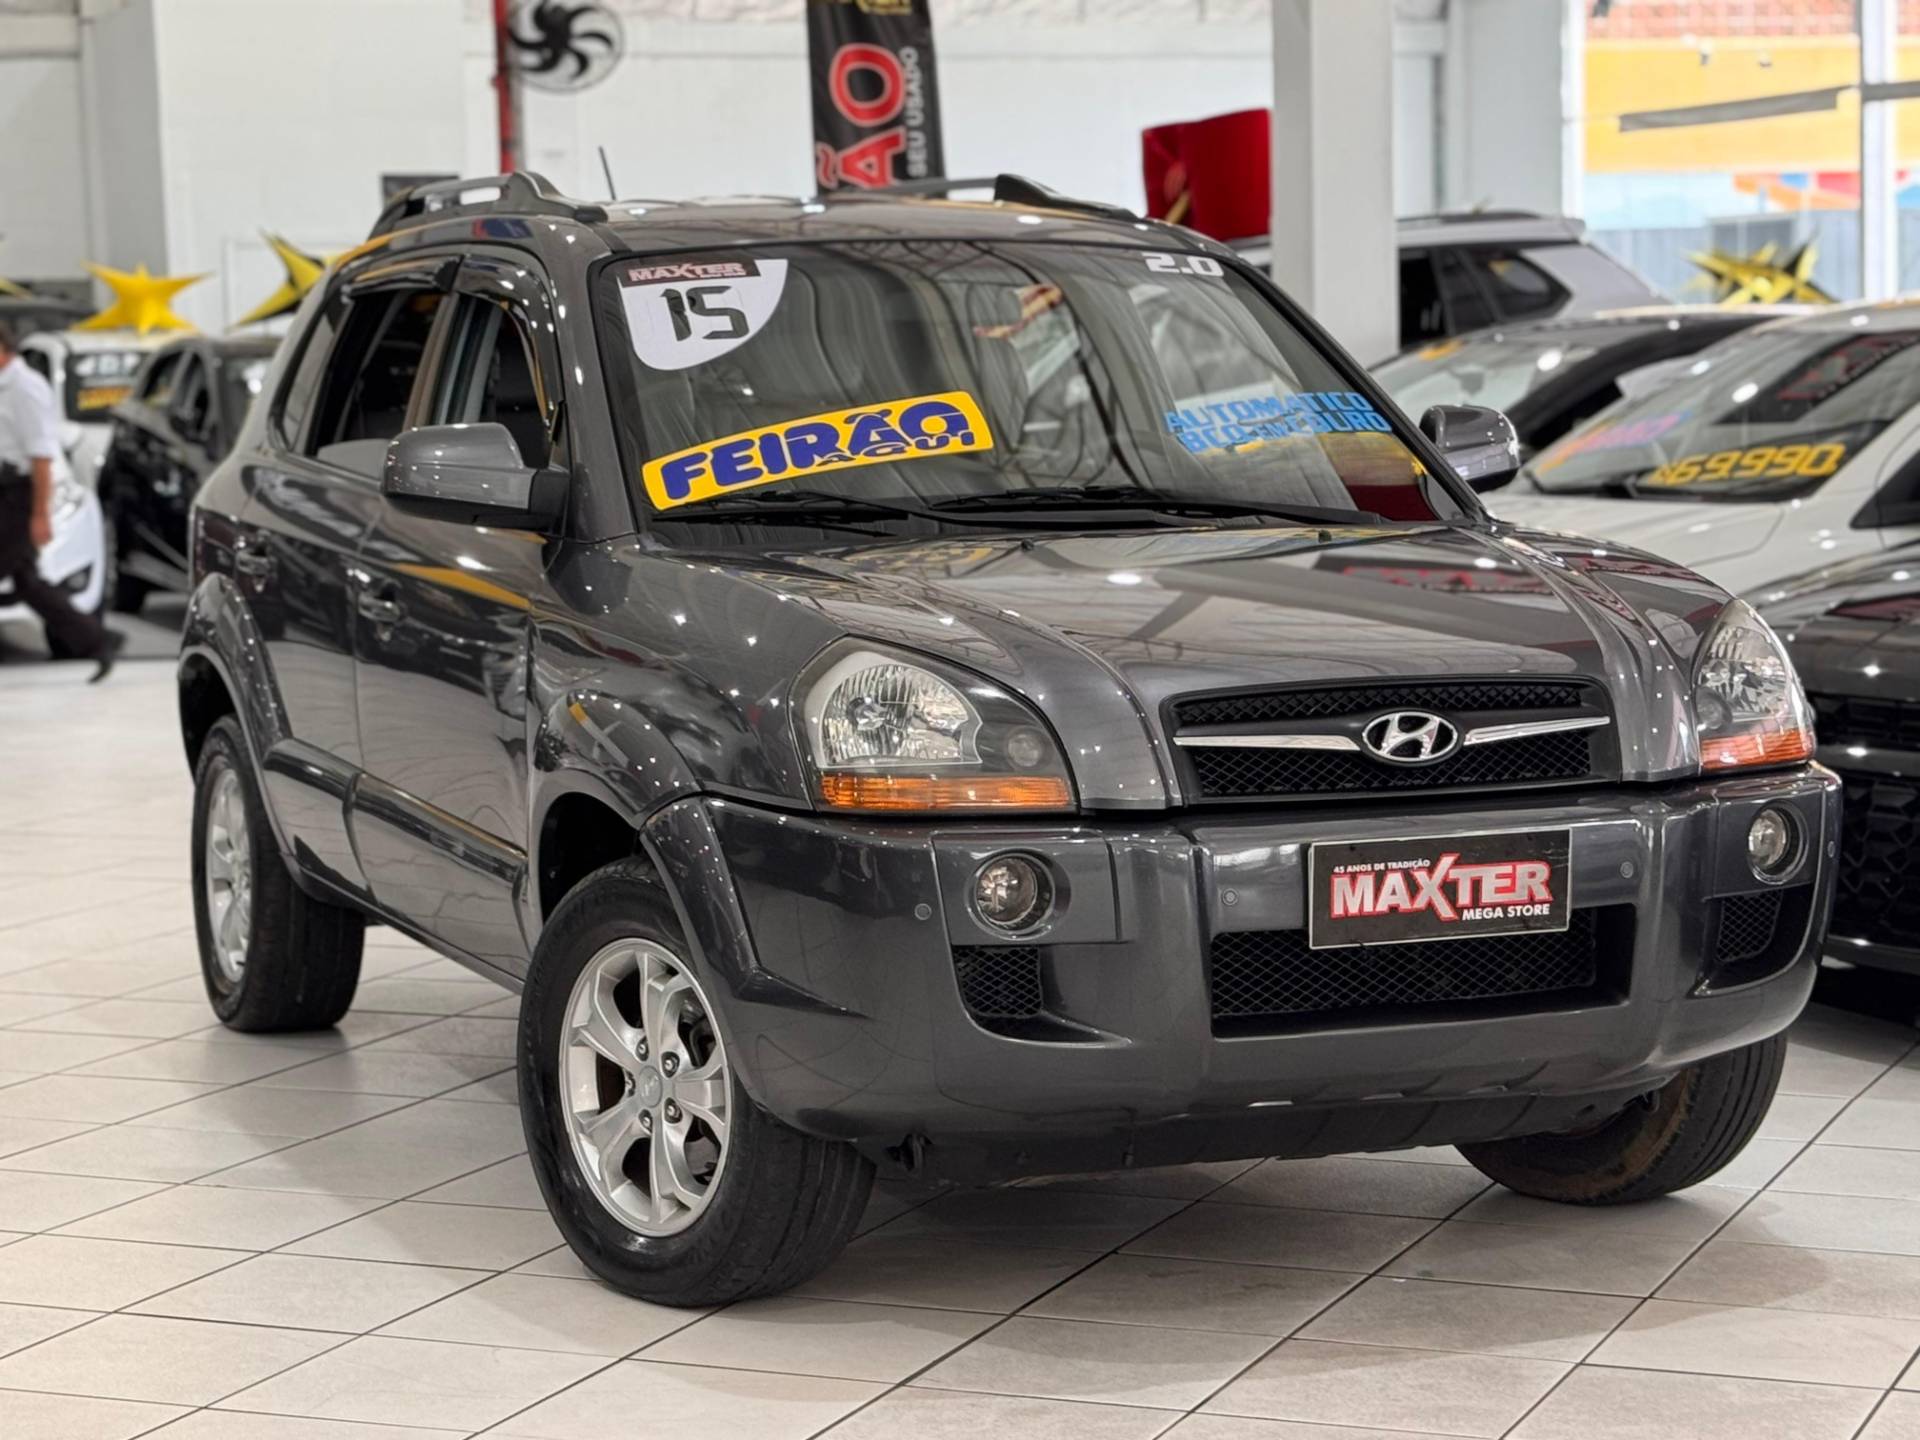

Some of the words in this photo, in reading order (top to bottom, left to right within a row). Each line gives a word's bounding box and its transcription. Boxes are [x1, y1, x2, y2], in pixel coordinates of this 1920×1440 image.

[899, 47, 924, 127] USADO
[905, 130, 928, 178] SEU
[627, 262, 747, 282] MAXTER
[1141, 251, 1224, 277] 2.0
[660, 285, 750, 342] 15
[660, 400, 971, 500] FEIRÃO
[1331, 853, 1553, 921] MAXTER
[1346, 863, 1372, 873] ANOS
[1373, 862, 1386, 871] DE
[1387, 858, 1431, 870] TRADIÇÃO
[1462, 905, 1503, 921] MEGA
[1507, 903, 1550, 918] STORE
